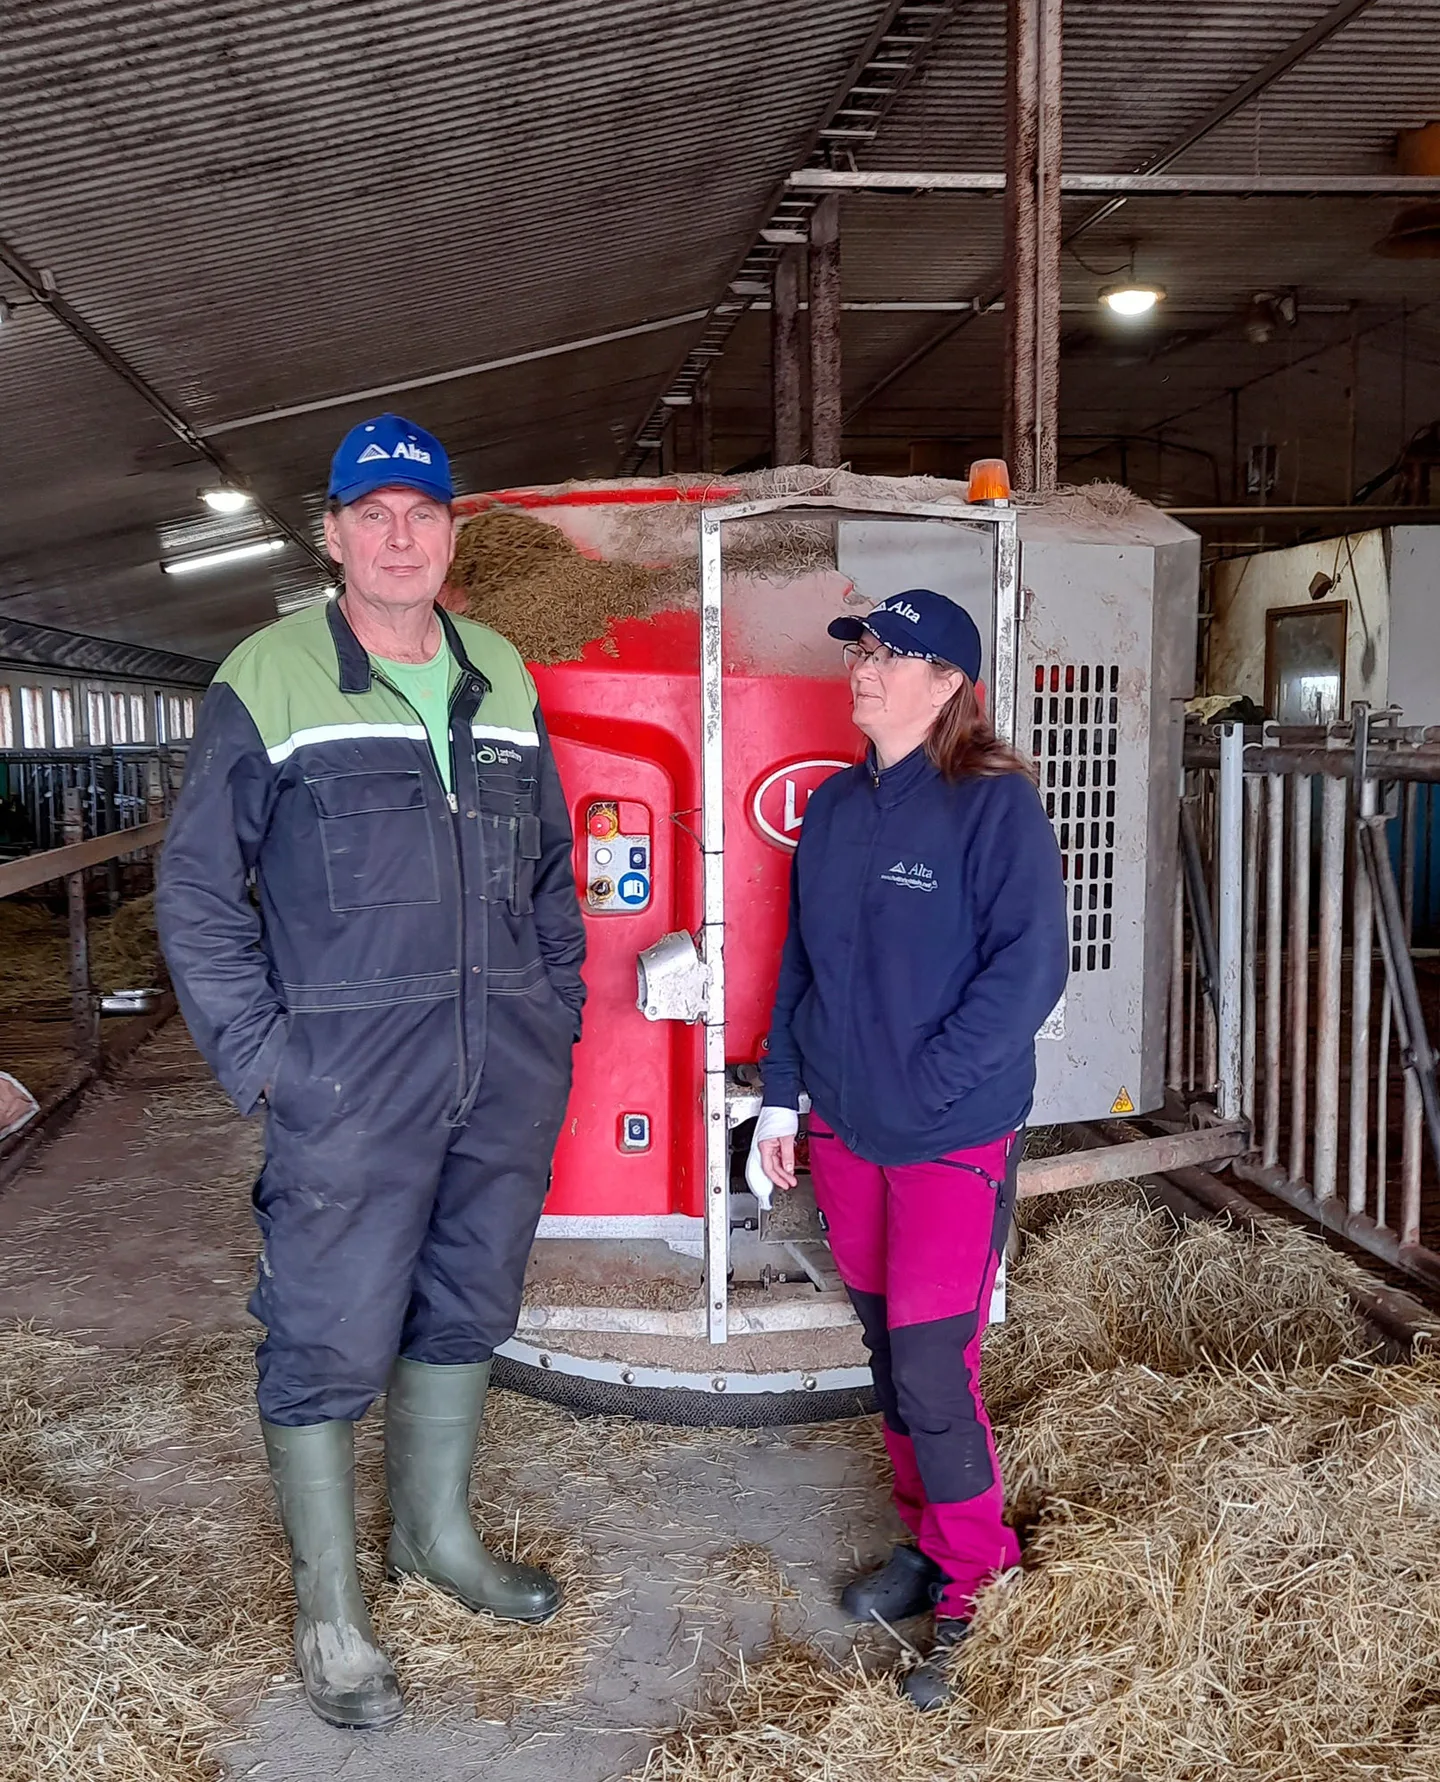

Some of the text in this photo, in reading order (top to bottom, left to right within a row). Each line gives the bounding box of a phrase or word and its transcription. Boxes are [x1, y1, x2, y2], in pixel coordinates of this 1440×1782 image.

[391, 441, 432, 465] Alta
[887, 600, 921, 625] Alta
[783, 778, 815, 832] L
[907, 862, 933, 879] Alta
